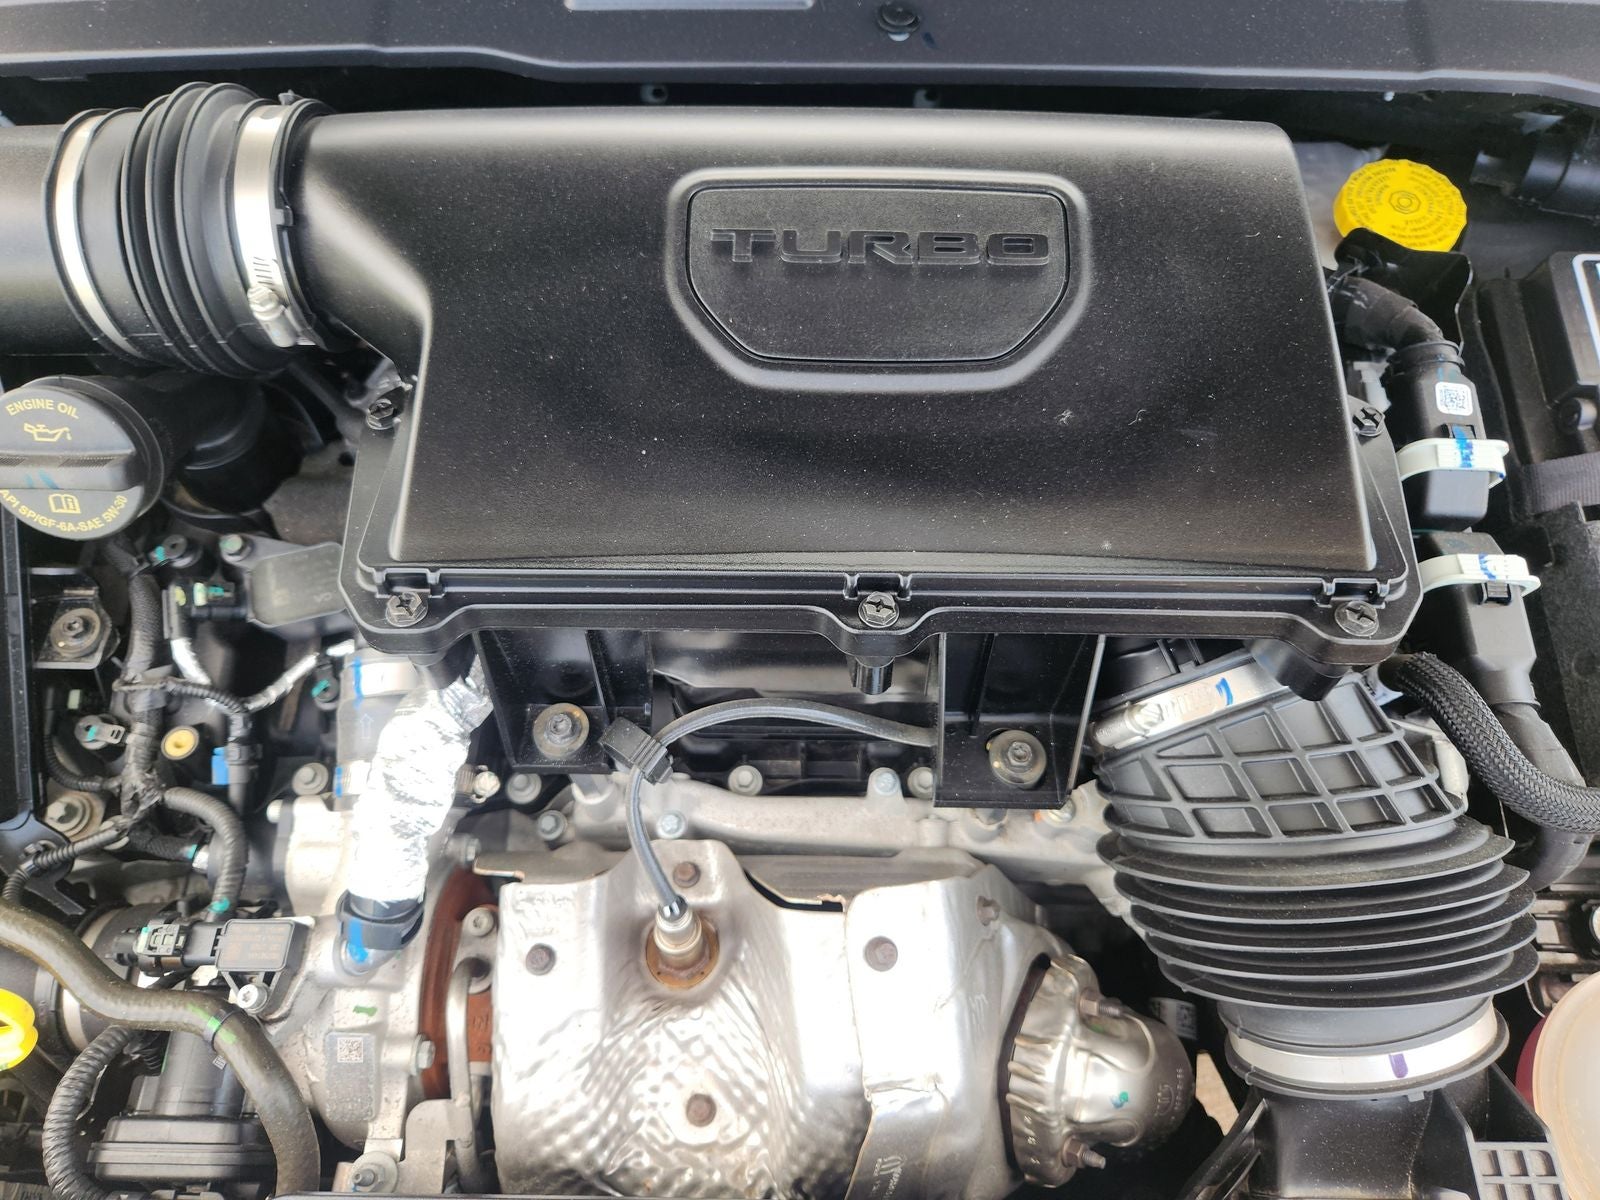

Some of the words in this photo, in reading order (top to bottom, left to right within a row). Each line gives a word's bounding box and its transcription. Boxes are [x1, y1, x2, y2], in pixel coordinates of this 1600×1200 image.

[711, 228, 1050, 265] TURBO
[5, 398, 55, 416] ENGINE
[57, 402, 80, 420] OIL
[0, 488, 21, 508] API
[101, 494, 128, 523] 5W-30
